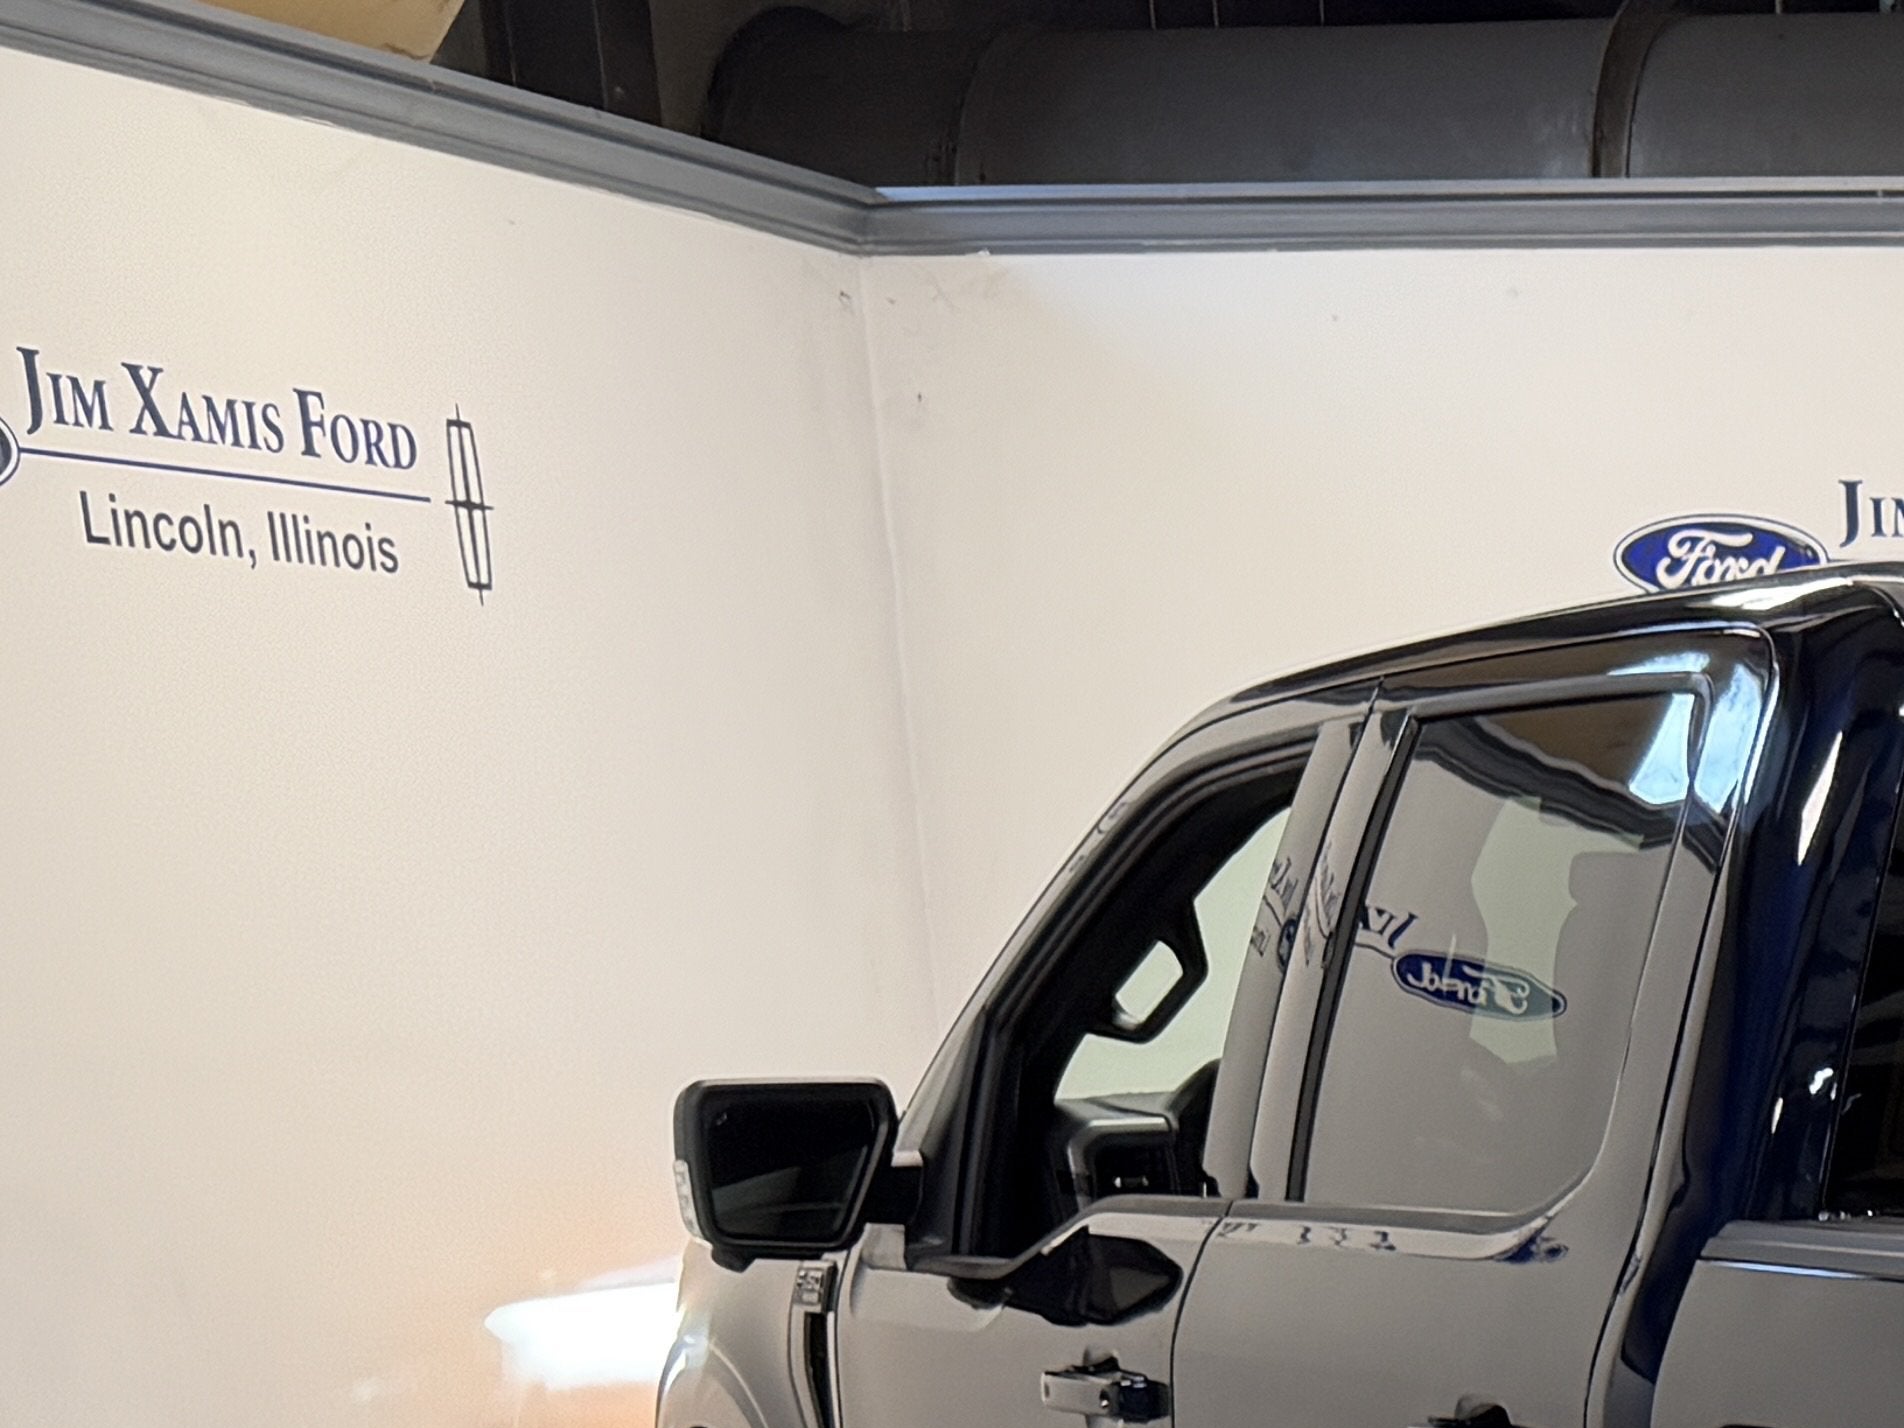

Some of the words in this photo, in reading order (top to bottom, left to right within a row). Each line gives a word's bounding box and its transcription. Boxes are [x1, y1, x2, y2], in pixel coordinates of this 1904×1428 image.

[16, 346, 113, 435] JIM
[121, 362, 285, 453] XAMIS
[292, 388, 417, 469] FORD
[79, 490, 257, 569] Lincoln,
[267, 511, 399, 573] Illinois
[1656, 529, 1786, 590] Ford
